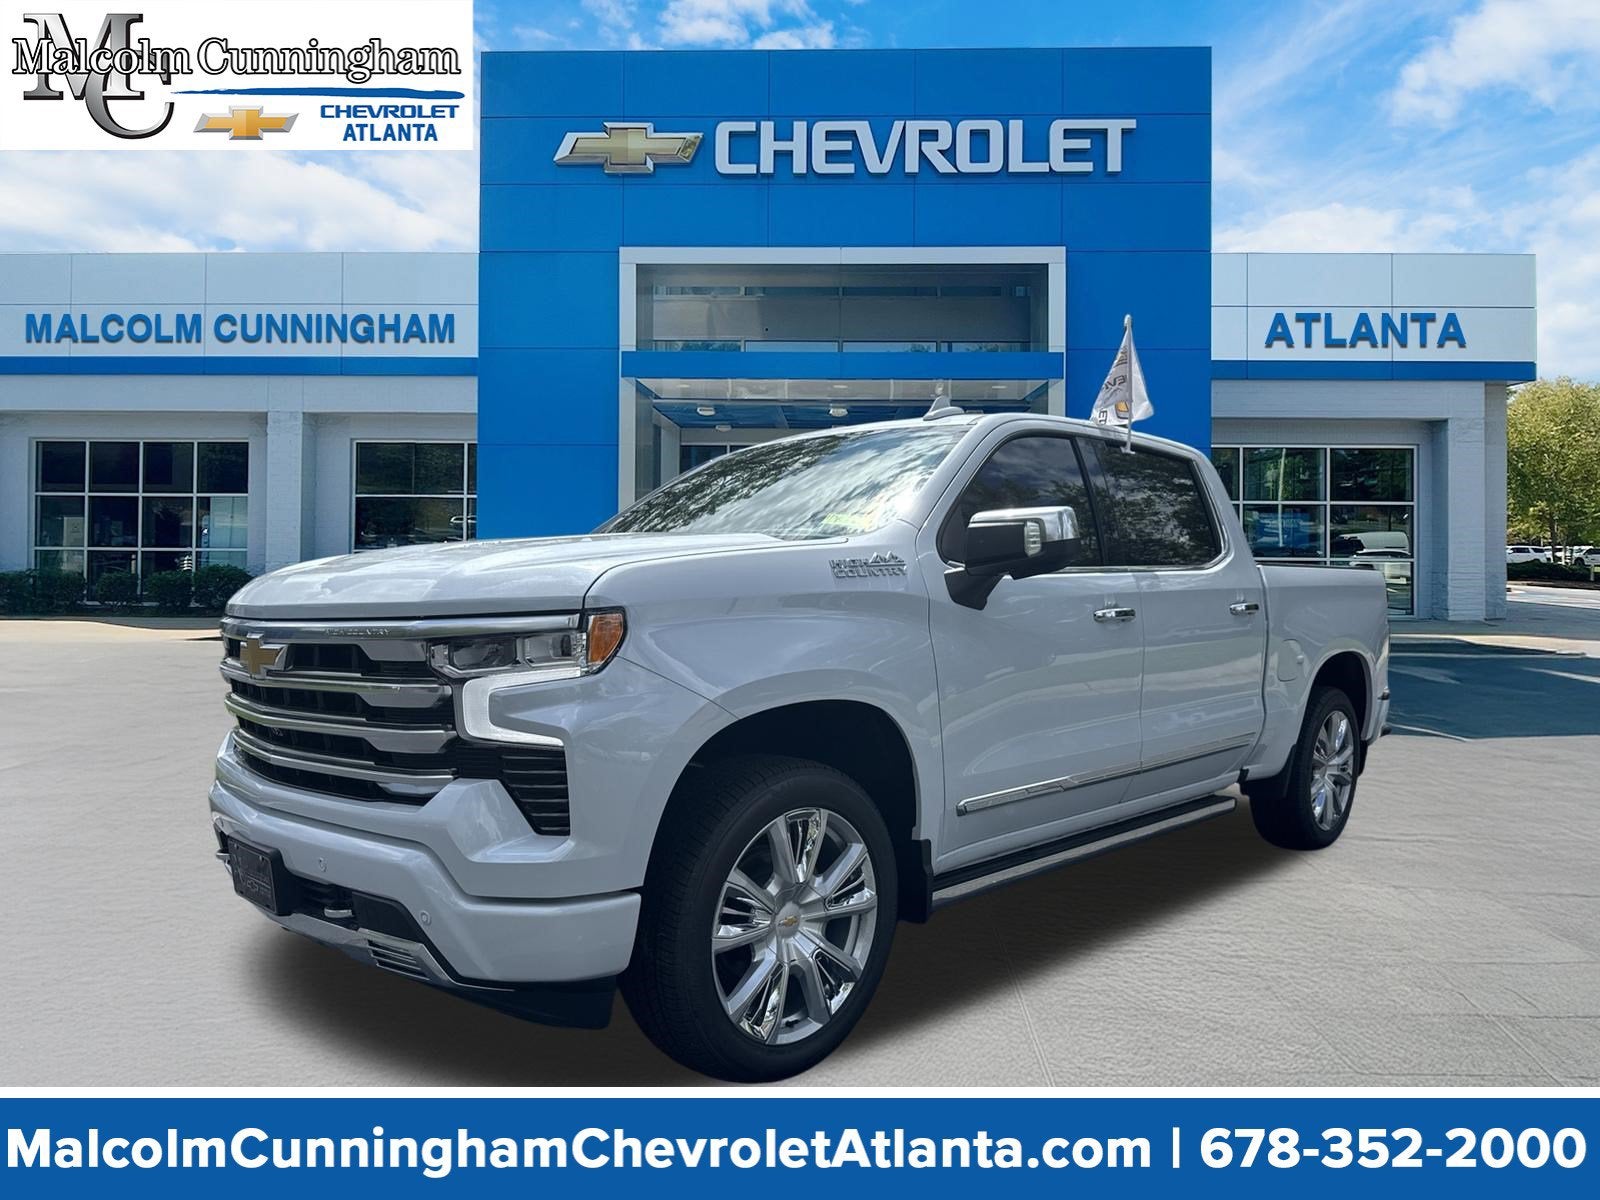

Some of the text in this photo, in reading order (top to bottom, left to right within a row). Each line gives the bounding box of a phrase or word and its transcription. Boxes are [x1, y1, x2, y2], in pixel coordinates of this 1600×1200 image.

[715, 118, 1137, 175] CHEVROLET
[25, 313, 455, 343] MALCOLM CUNNINGHAM
[1264, 312, 1467, 349] ATLANTA
